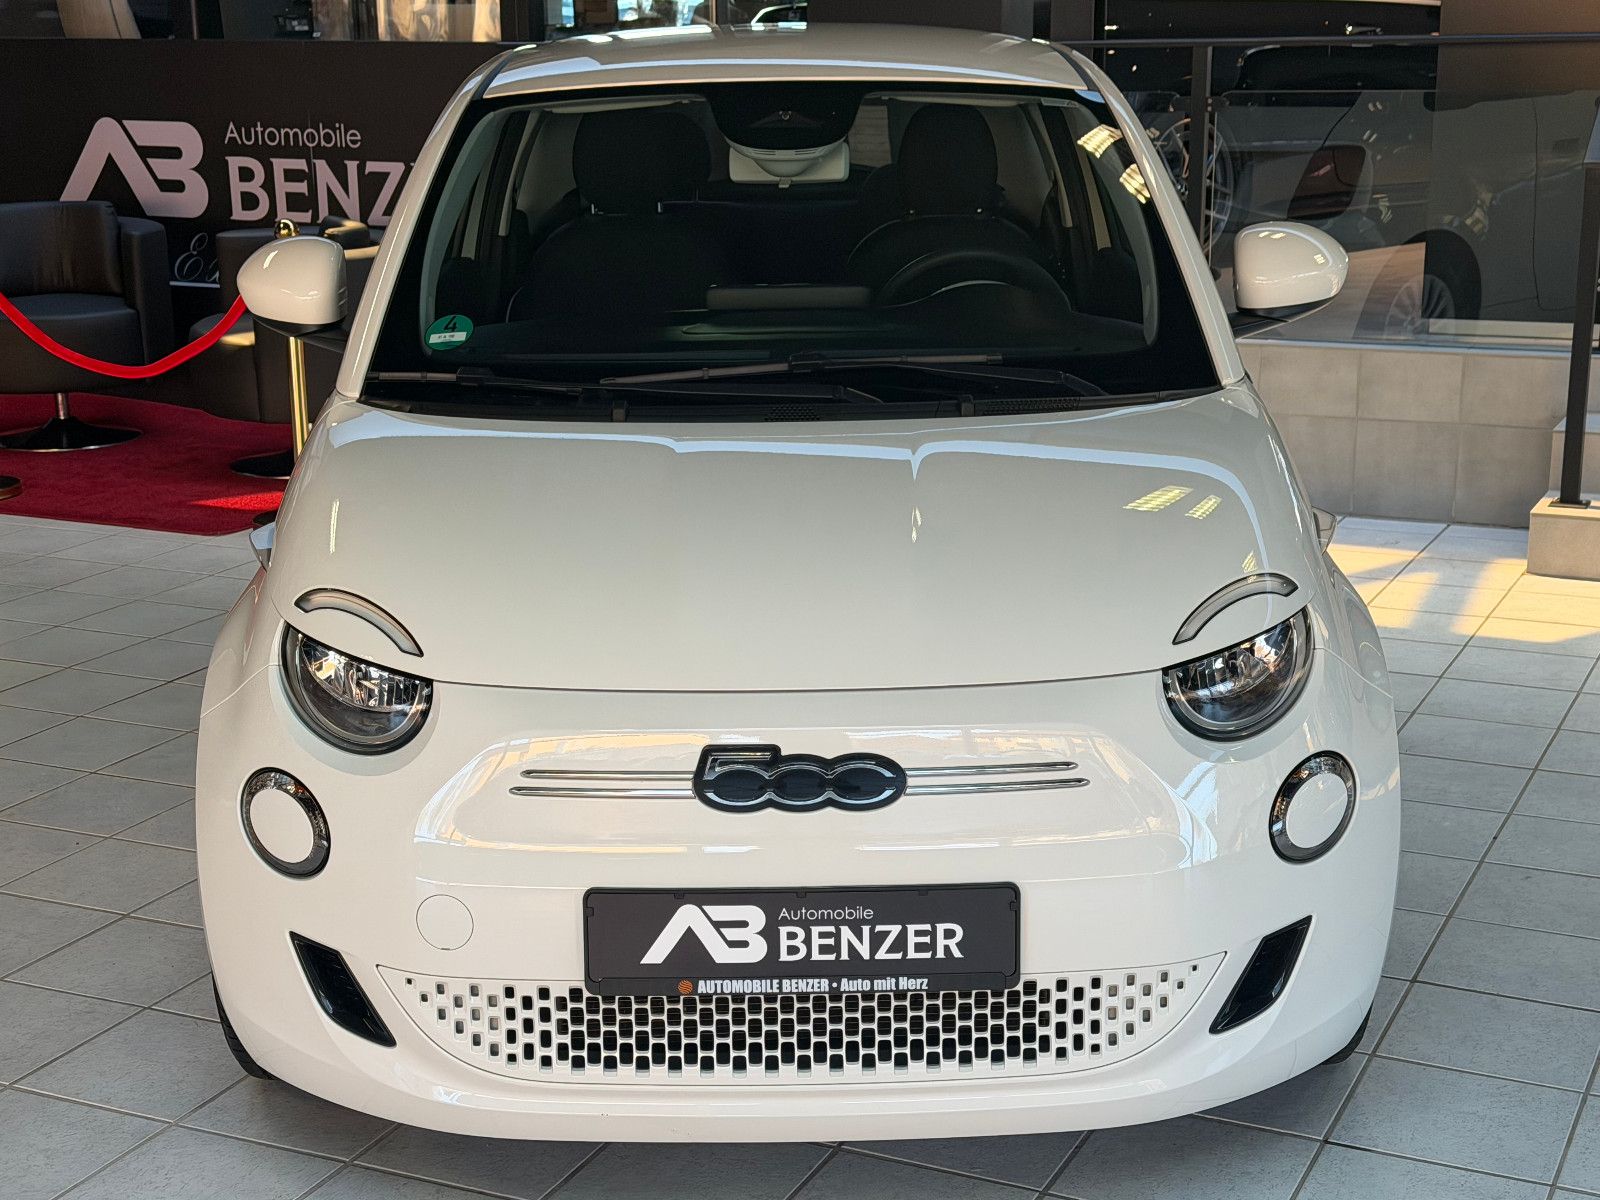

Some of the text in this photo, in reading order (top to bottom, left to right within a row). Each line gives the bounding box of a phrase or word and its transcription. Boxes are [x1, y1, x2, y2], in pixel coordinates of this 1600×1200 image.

[225, 121, 362, 149] Automobile
[225, 156, 415, 226] BENZ
[444, 315, 457, 332] 4
[693, 744, 907, 813] 500
[778, 906, 874, 921] Automobile
[778, 923, 965, 962] BENZER
[698, 977, 929, 994] AUTOMOBILE BENZER Auto mit Herz
